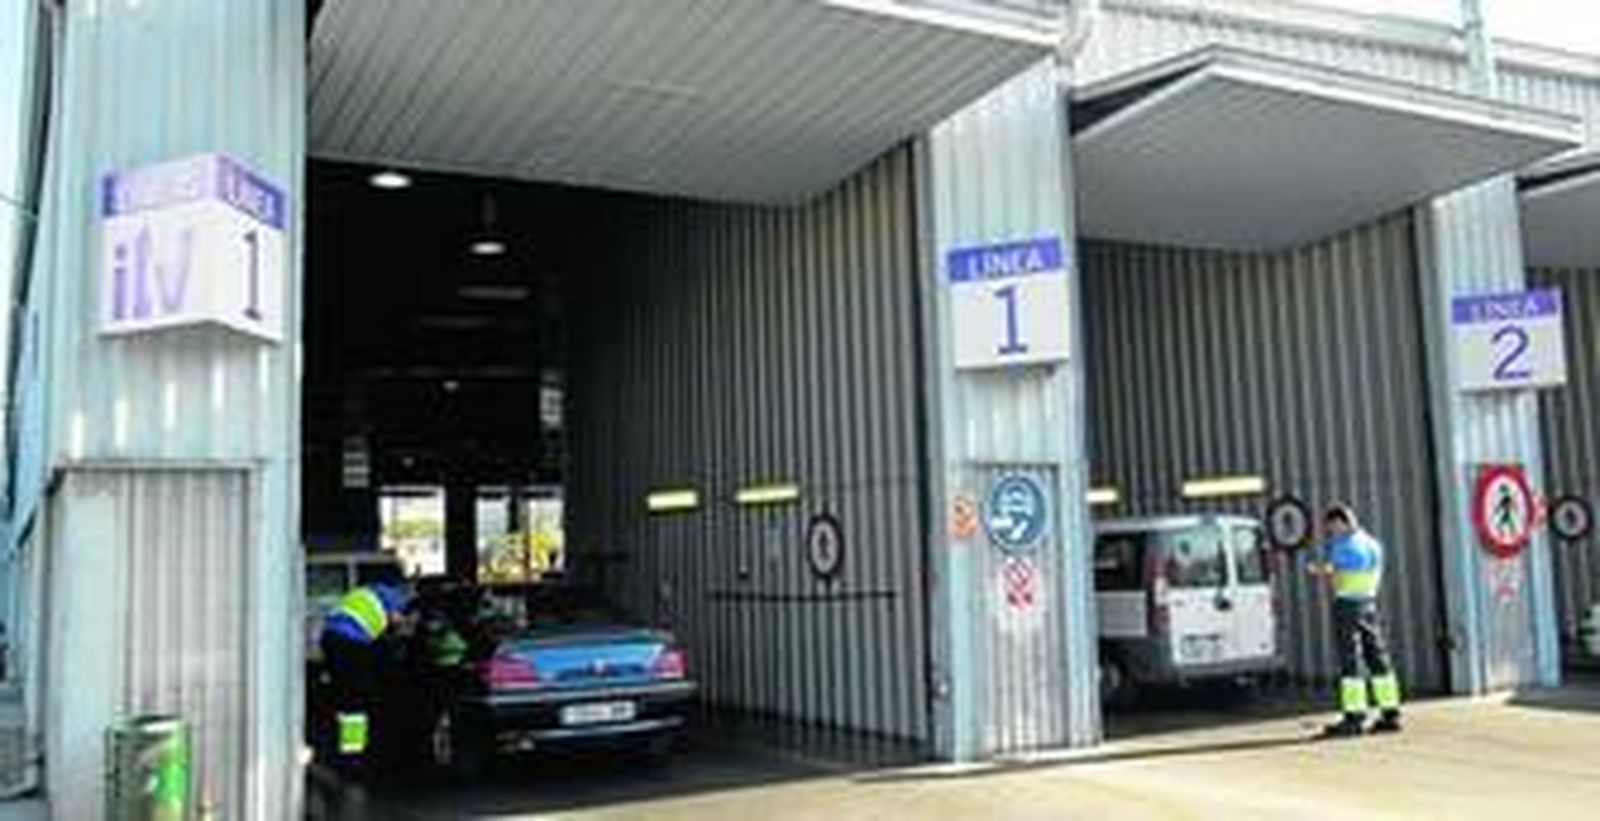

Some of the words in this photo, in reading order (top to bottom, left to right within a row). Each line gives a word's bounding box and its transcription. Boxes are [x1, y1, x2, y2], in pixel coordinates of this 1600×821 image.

[242, 229, 262, 320] 1
[994, 286, 1027, 355] 1
[1491, 326, 1529, 380] 2
